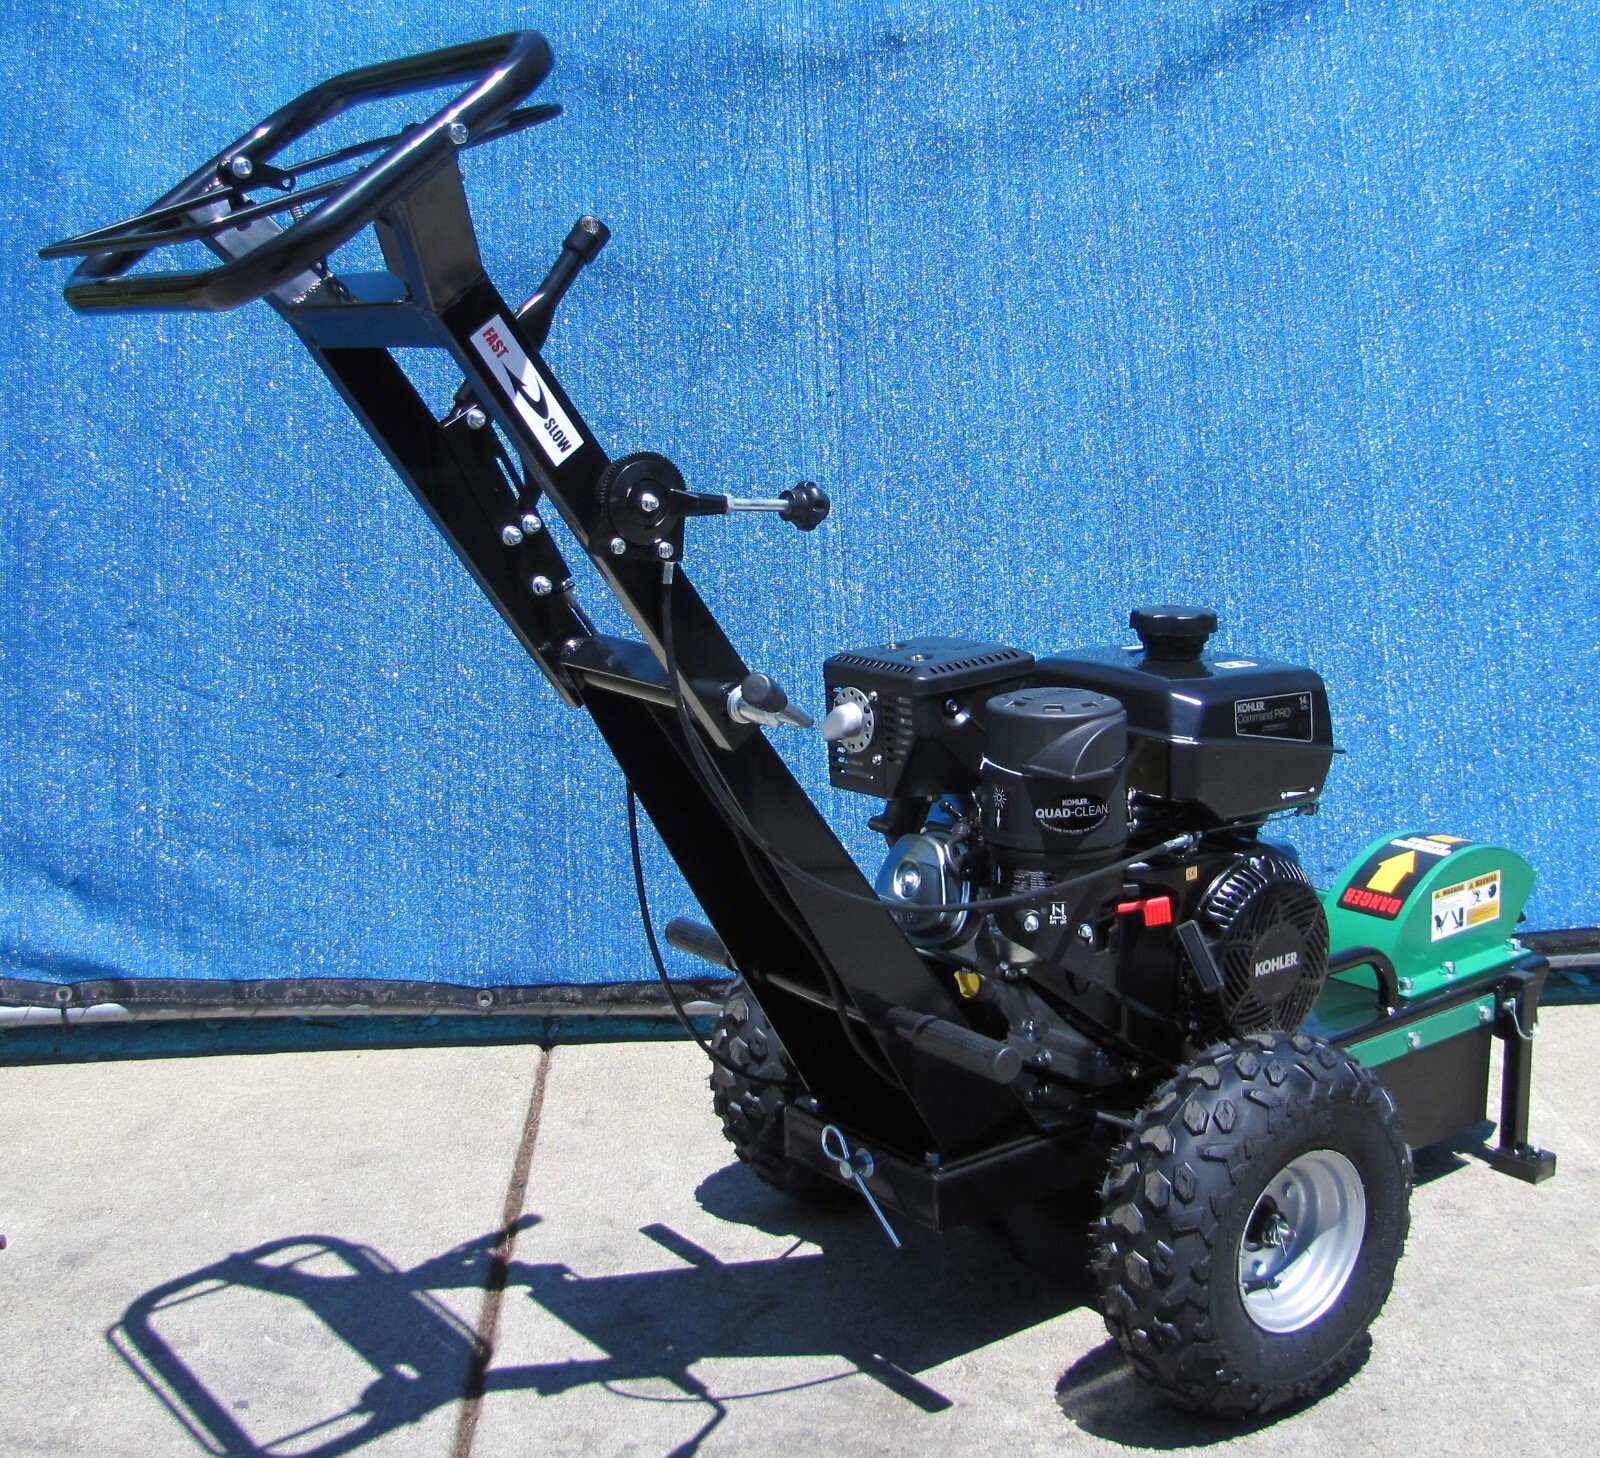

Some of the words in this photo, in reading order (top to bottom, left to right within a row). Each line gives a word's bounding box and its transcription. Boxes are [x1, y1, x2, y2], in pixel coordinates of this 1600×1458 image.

[482, 326, 510, 358] FAST
[544, 417, 572, 453] SLOW
[1237, 701, 1265, 713] KOHLER
[1299, 695, 1307, 705] 14
[1237, 711, 1273, 724] Command
[1274, 707, 1291, 719] PRO
[1035, 803, 1109, 819] QUAD-CLEAN
[1062, 798, 1088, 807] KOHLER
[1342, 887, 1403, 914] DANGER
[1255, 951, 1298, 977] KOHLER
